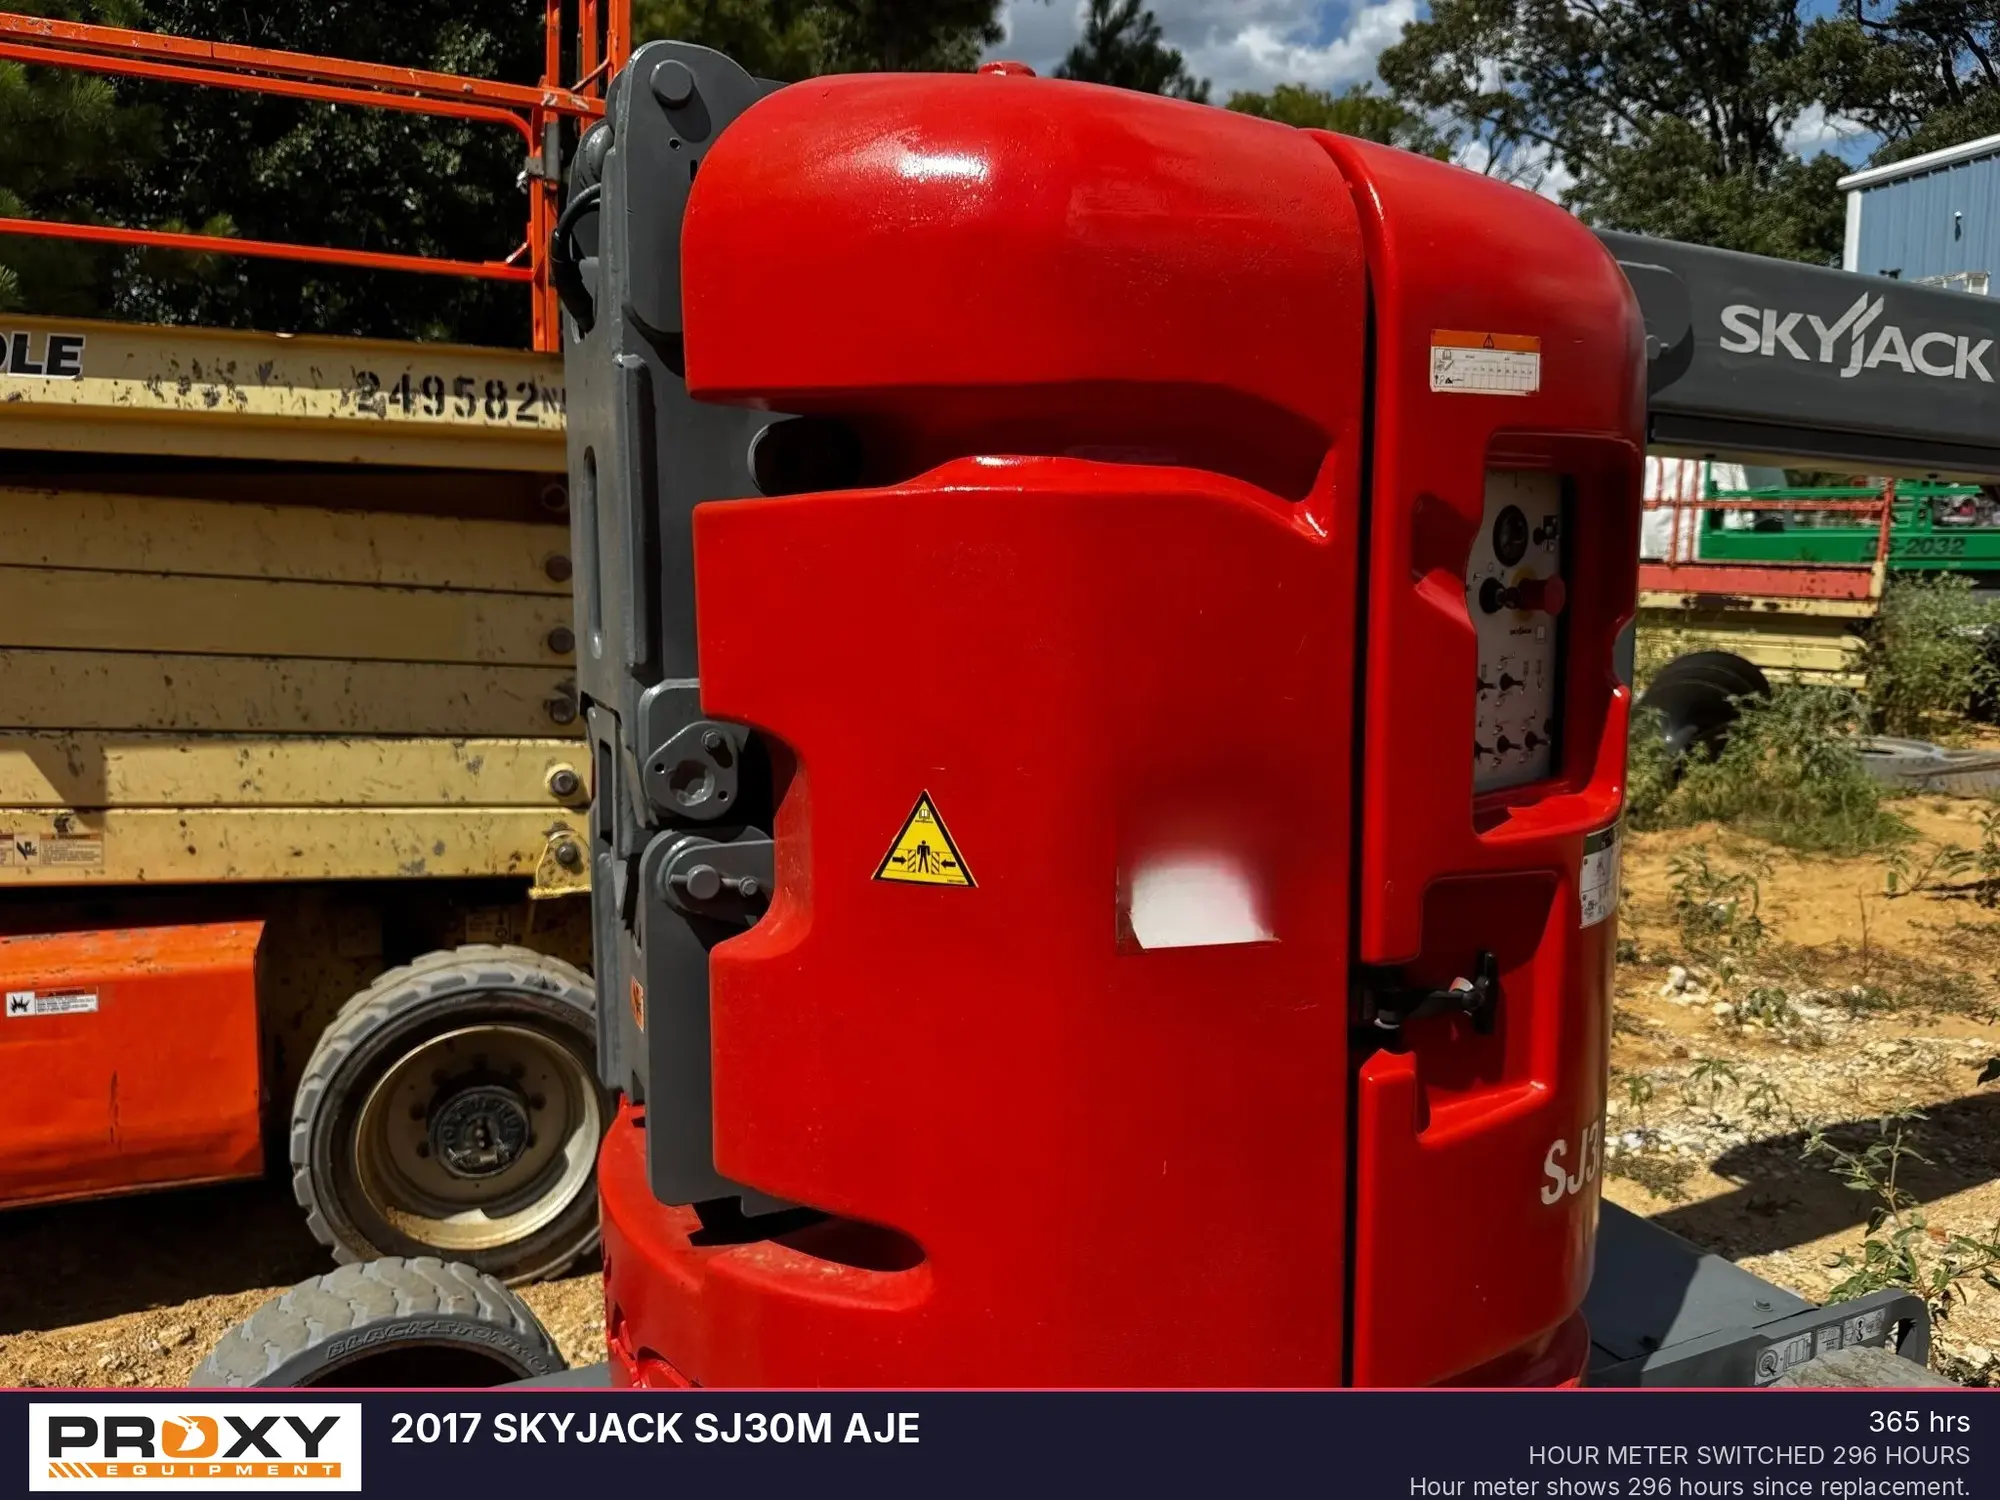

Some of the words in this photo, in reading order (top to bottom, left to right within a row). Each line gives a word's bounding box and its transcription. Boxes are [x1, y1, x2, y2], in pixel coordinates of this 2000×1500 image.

[0, 330, 86, 379] LE
[1720, 291, 1995, 383] SKYJACK
[1541, 1121, 1600, 1205] SJ3
